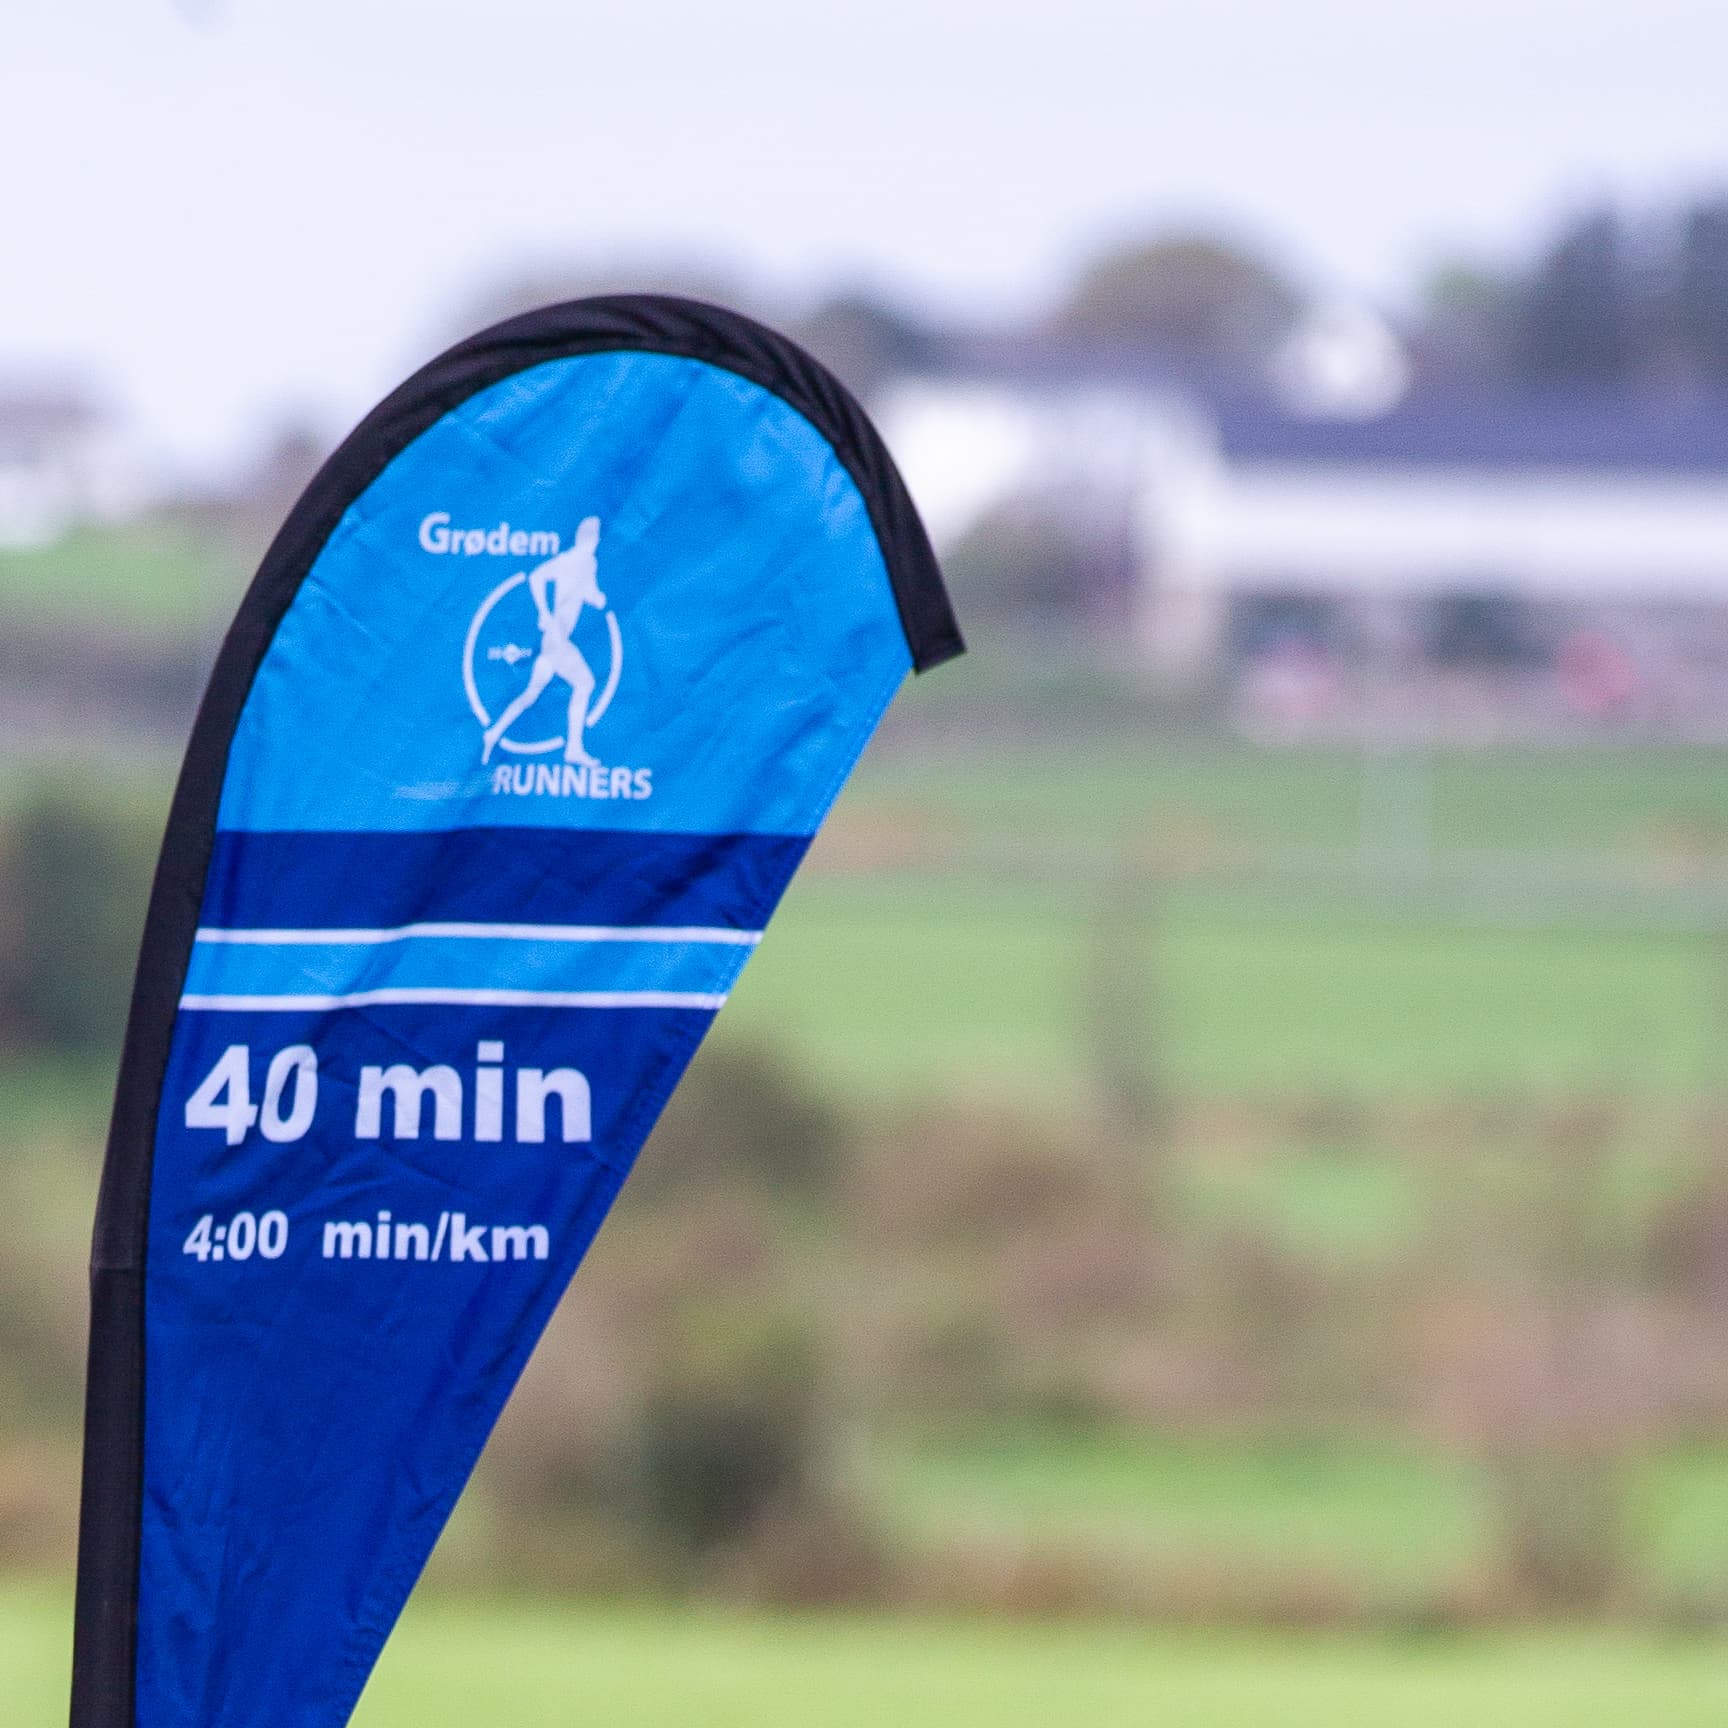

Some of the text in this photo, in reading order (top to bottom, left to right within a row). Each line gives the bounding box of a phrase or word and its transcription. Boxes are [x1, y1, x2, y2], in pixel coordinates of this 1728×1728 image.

[419, 511, 560, 556] Grødem
[491, 763, 653, 800] RUNNERS
[183, 1040, 592, 1146] 40 min
[182, 1210, 549, 1262] 4:00 min/km
